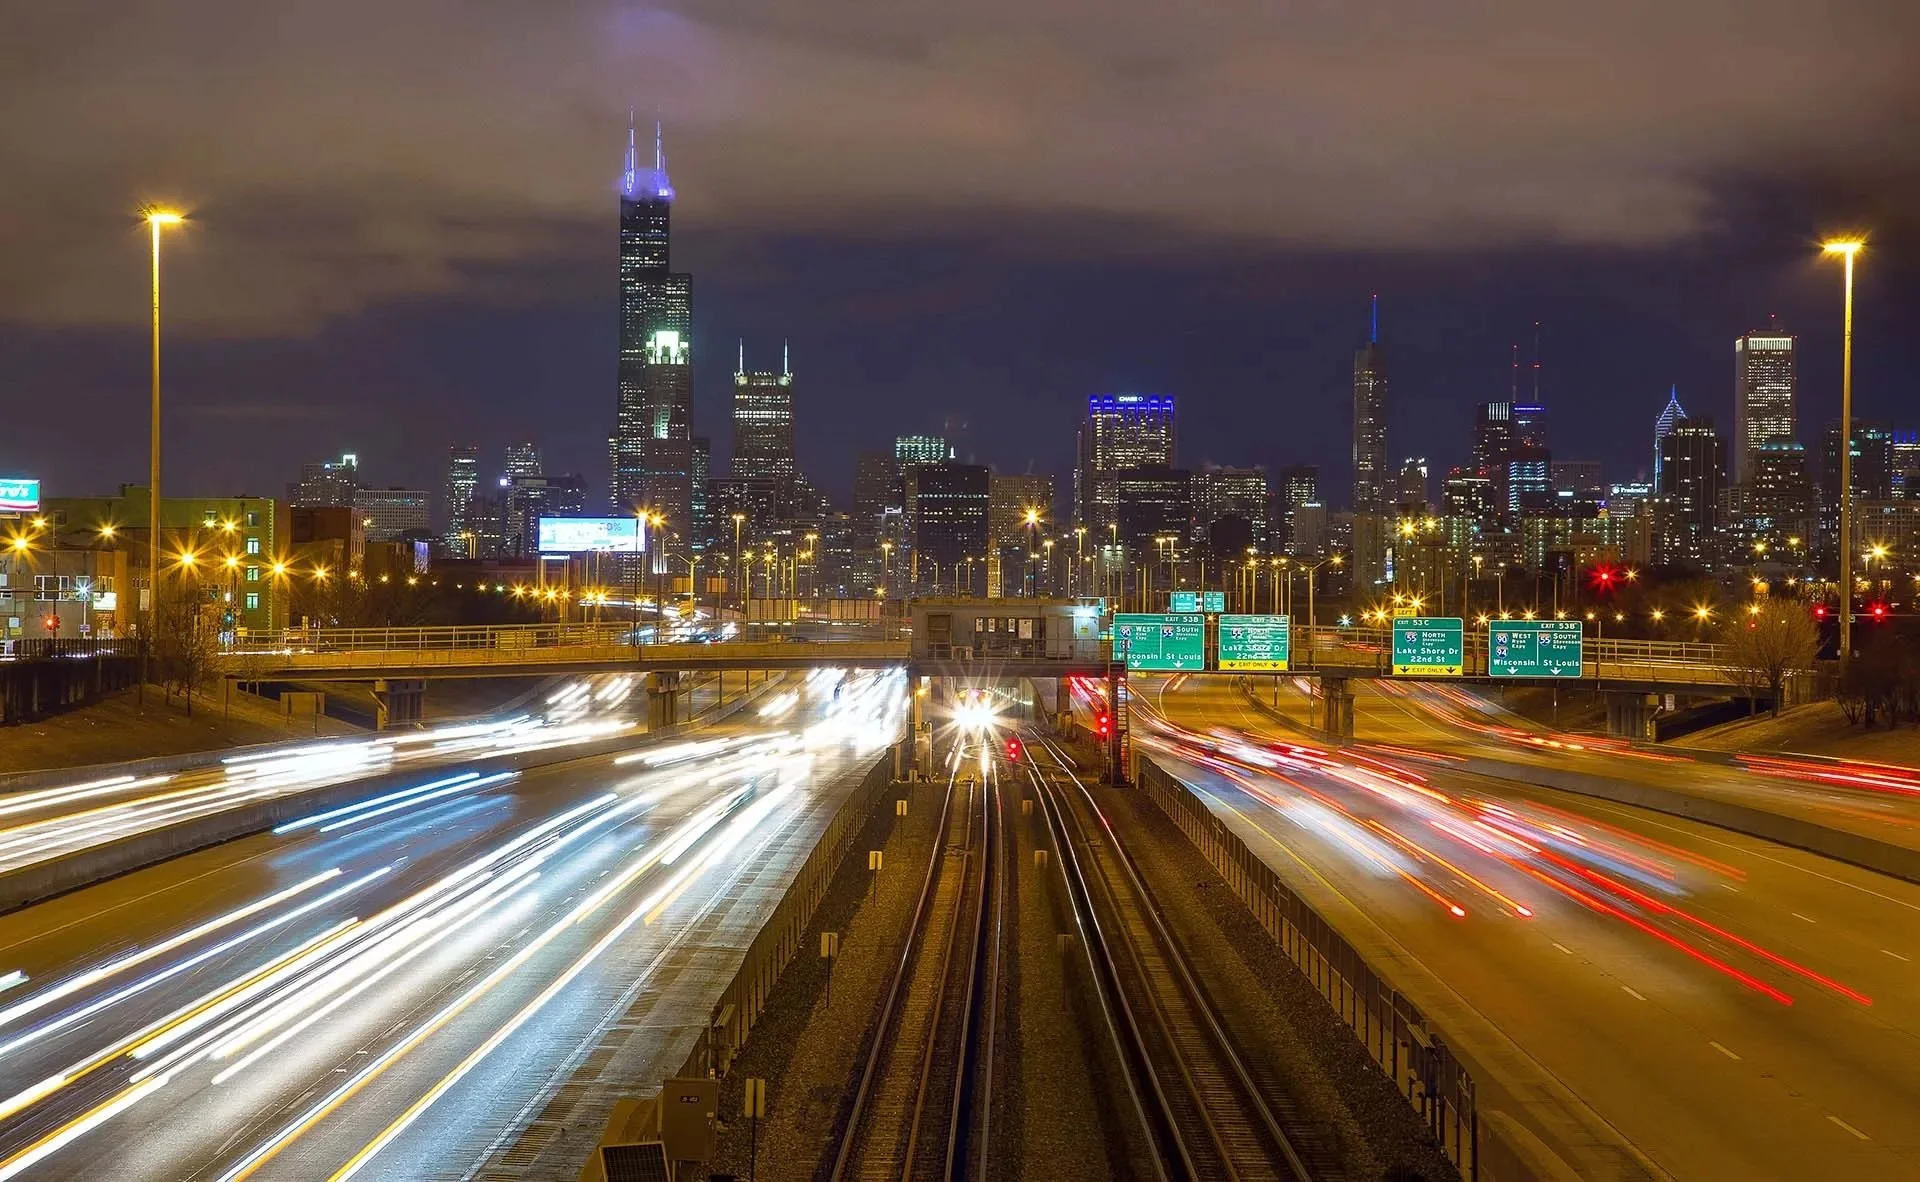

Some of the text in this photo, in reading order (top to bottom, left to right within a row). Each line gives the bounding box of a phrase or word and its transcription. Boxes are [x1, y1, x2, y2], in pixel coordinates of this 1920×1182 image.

[1420, 647, 1446, 655] Shore
[1448, 647, 1459, 655] Dr
[1497, 648, 1508, 656] 94
[1493, 658, 1536, 666] Wisconsin
[1543, 659, 1580, 667] St Louis
